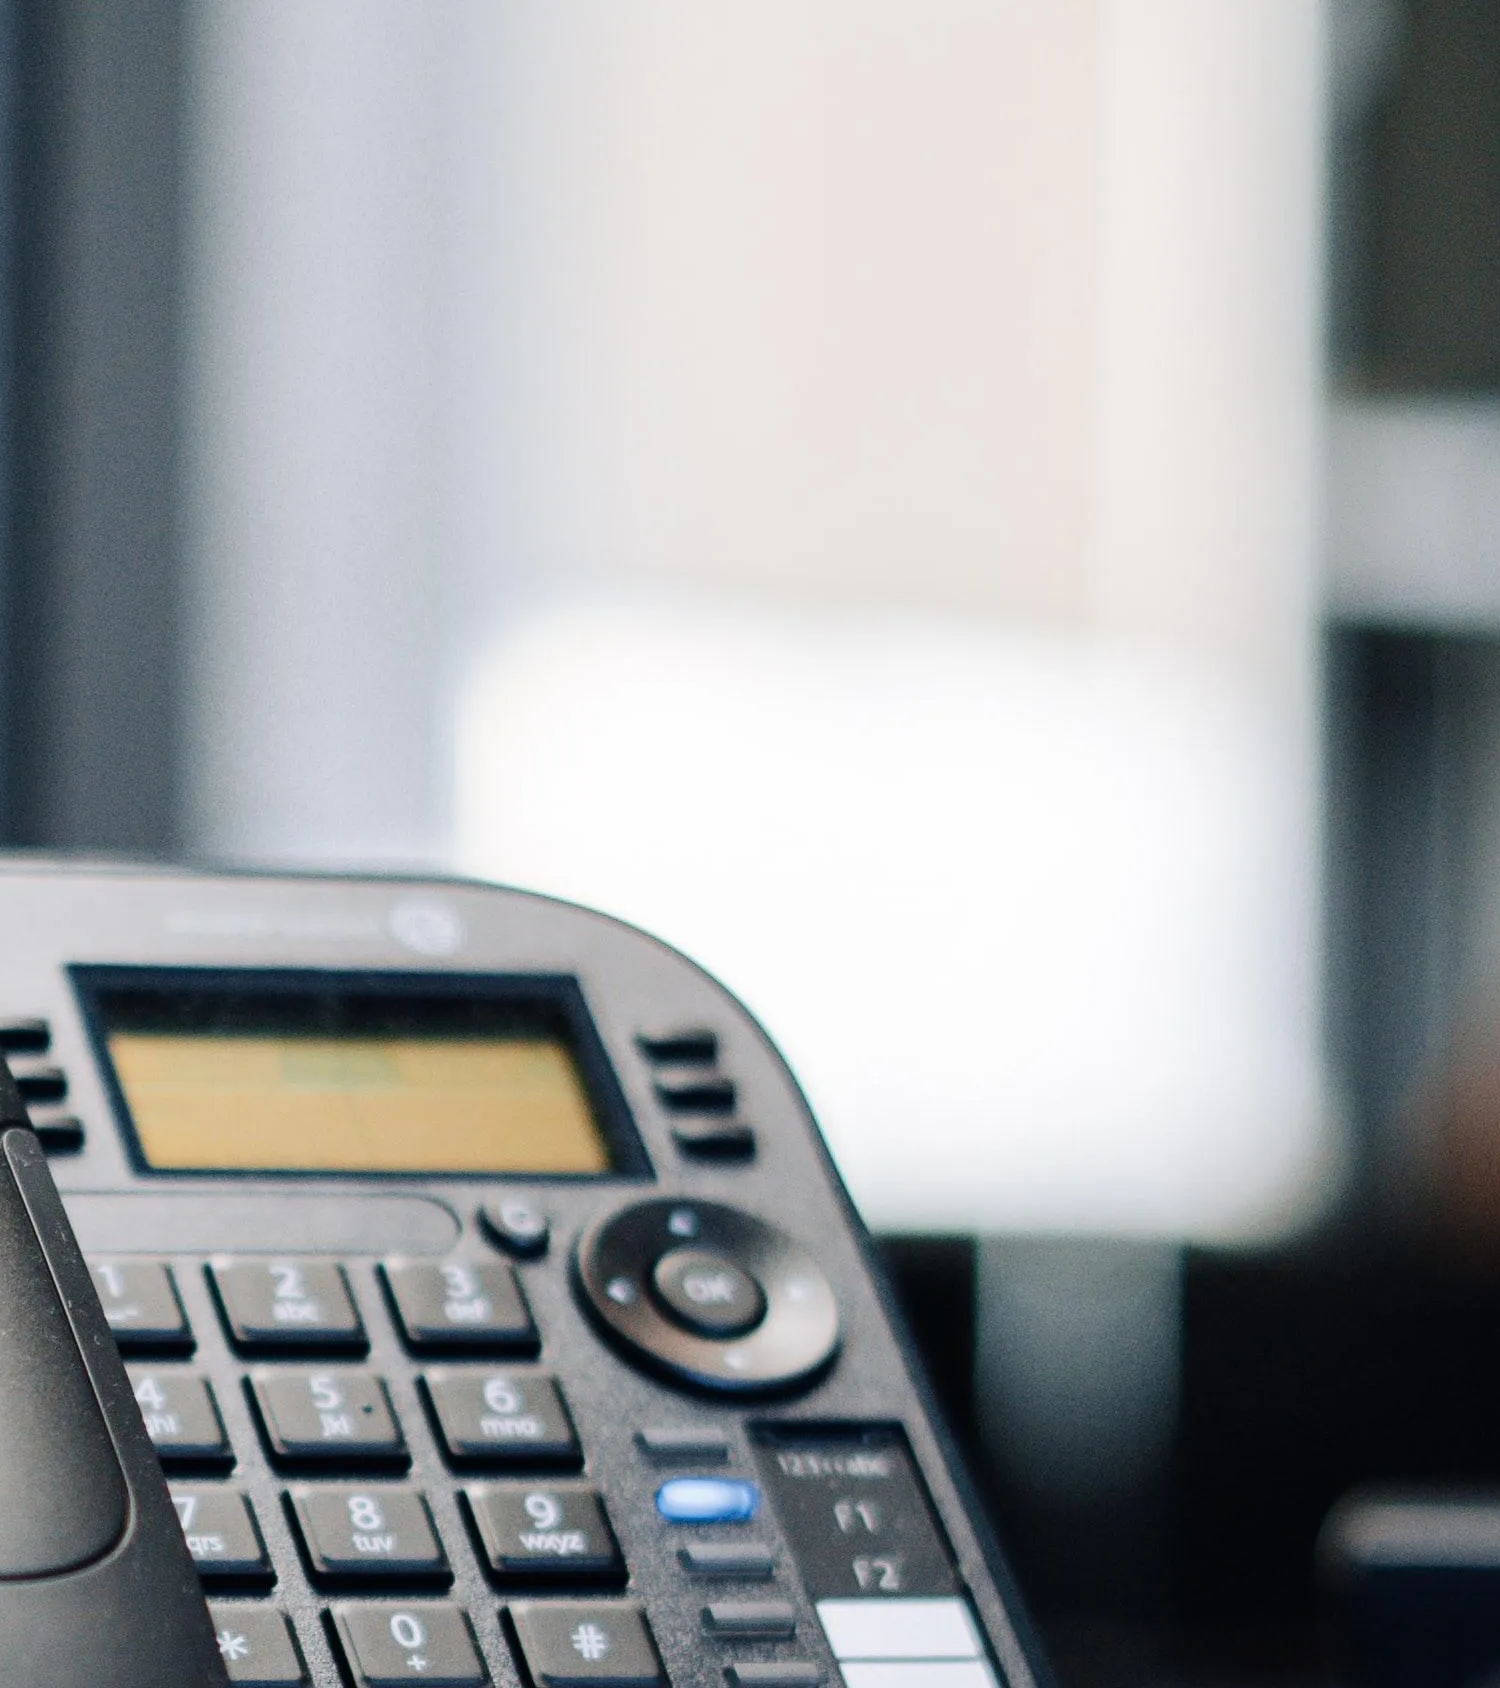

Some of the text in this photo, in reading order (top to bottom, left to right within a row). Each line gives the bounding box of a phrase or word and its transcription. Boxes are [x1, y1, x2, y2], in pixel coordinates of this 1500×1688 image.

[98, 1266, 123, 1297] 1
[268, 1266, 305, 1298] 2
[442, 1265, 474, 1299] 3
[684, 1272, 734, 1303] OK
[134, 1378, 165, 1410] 4
[310, 1376, 342, 1410] 5
[484, 1378, 519, 1414] 6
[172, 1497, 196, 1530] 7
[348, 1497, 381, 1530] 8
[525, 1494, 560, 1529] 9
[834, 1500, 874, 1534] F1
[186, 1534, 223, 1556] qrs
[352, 1533, 392, 1552] tuv
[518, 1533, 585, 1556] wxyz
[853, 1559, 899, 1591] F2
[390, 1614, 423, 1649] 0
[571, 1624, 607, 1659] #
